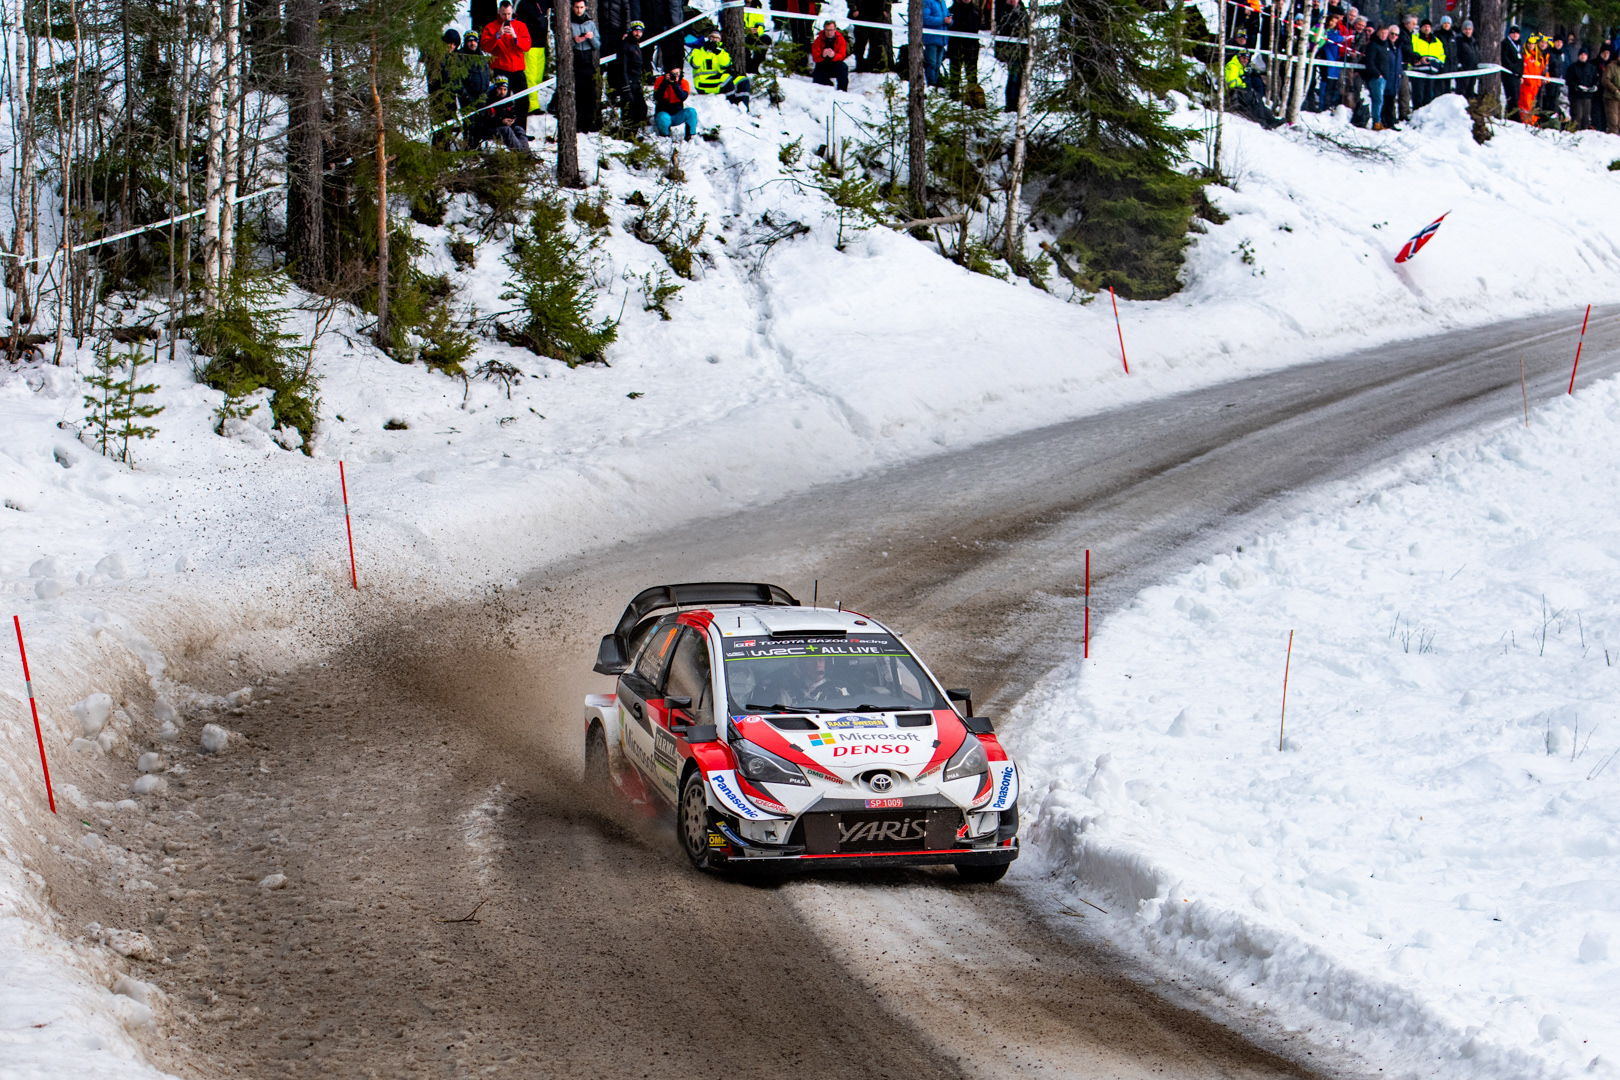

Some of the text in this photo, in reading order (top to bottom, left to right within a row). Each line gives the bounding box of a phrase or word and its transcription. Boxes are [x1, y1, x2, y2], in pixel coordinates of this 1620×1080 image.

[821, 646, 848, 654] ALL
[848, 646, 880, 654] LIVE
[838, 732, 921, 742] Microsoft
[833, 744, 911, 758] DENSO
[788, 777, 807, 785] PIAA
[806, 768, 844, 785] DMG MORI
[992, 766, 1014, 809] Panasonic
[711, 774, 759, 819] Panasonic
[870, 799, 902, 808] SP 1009
